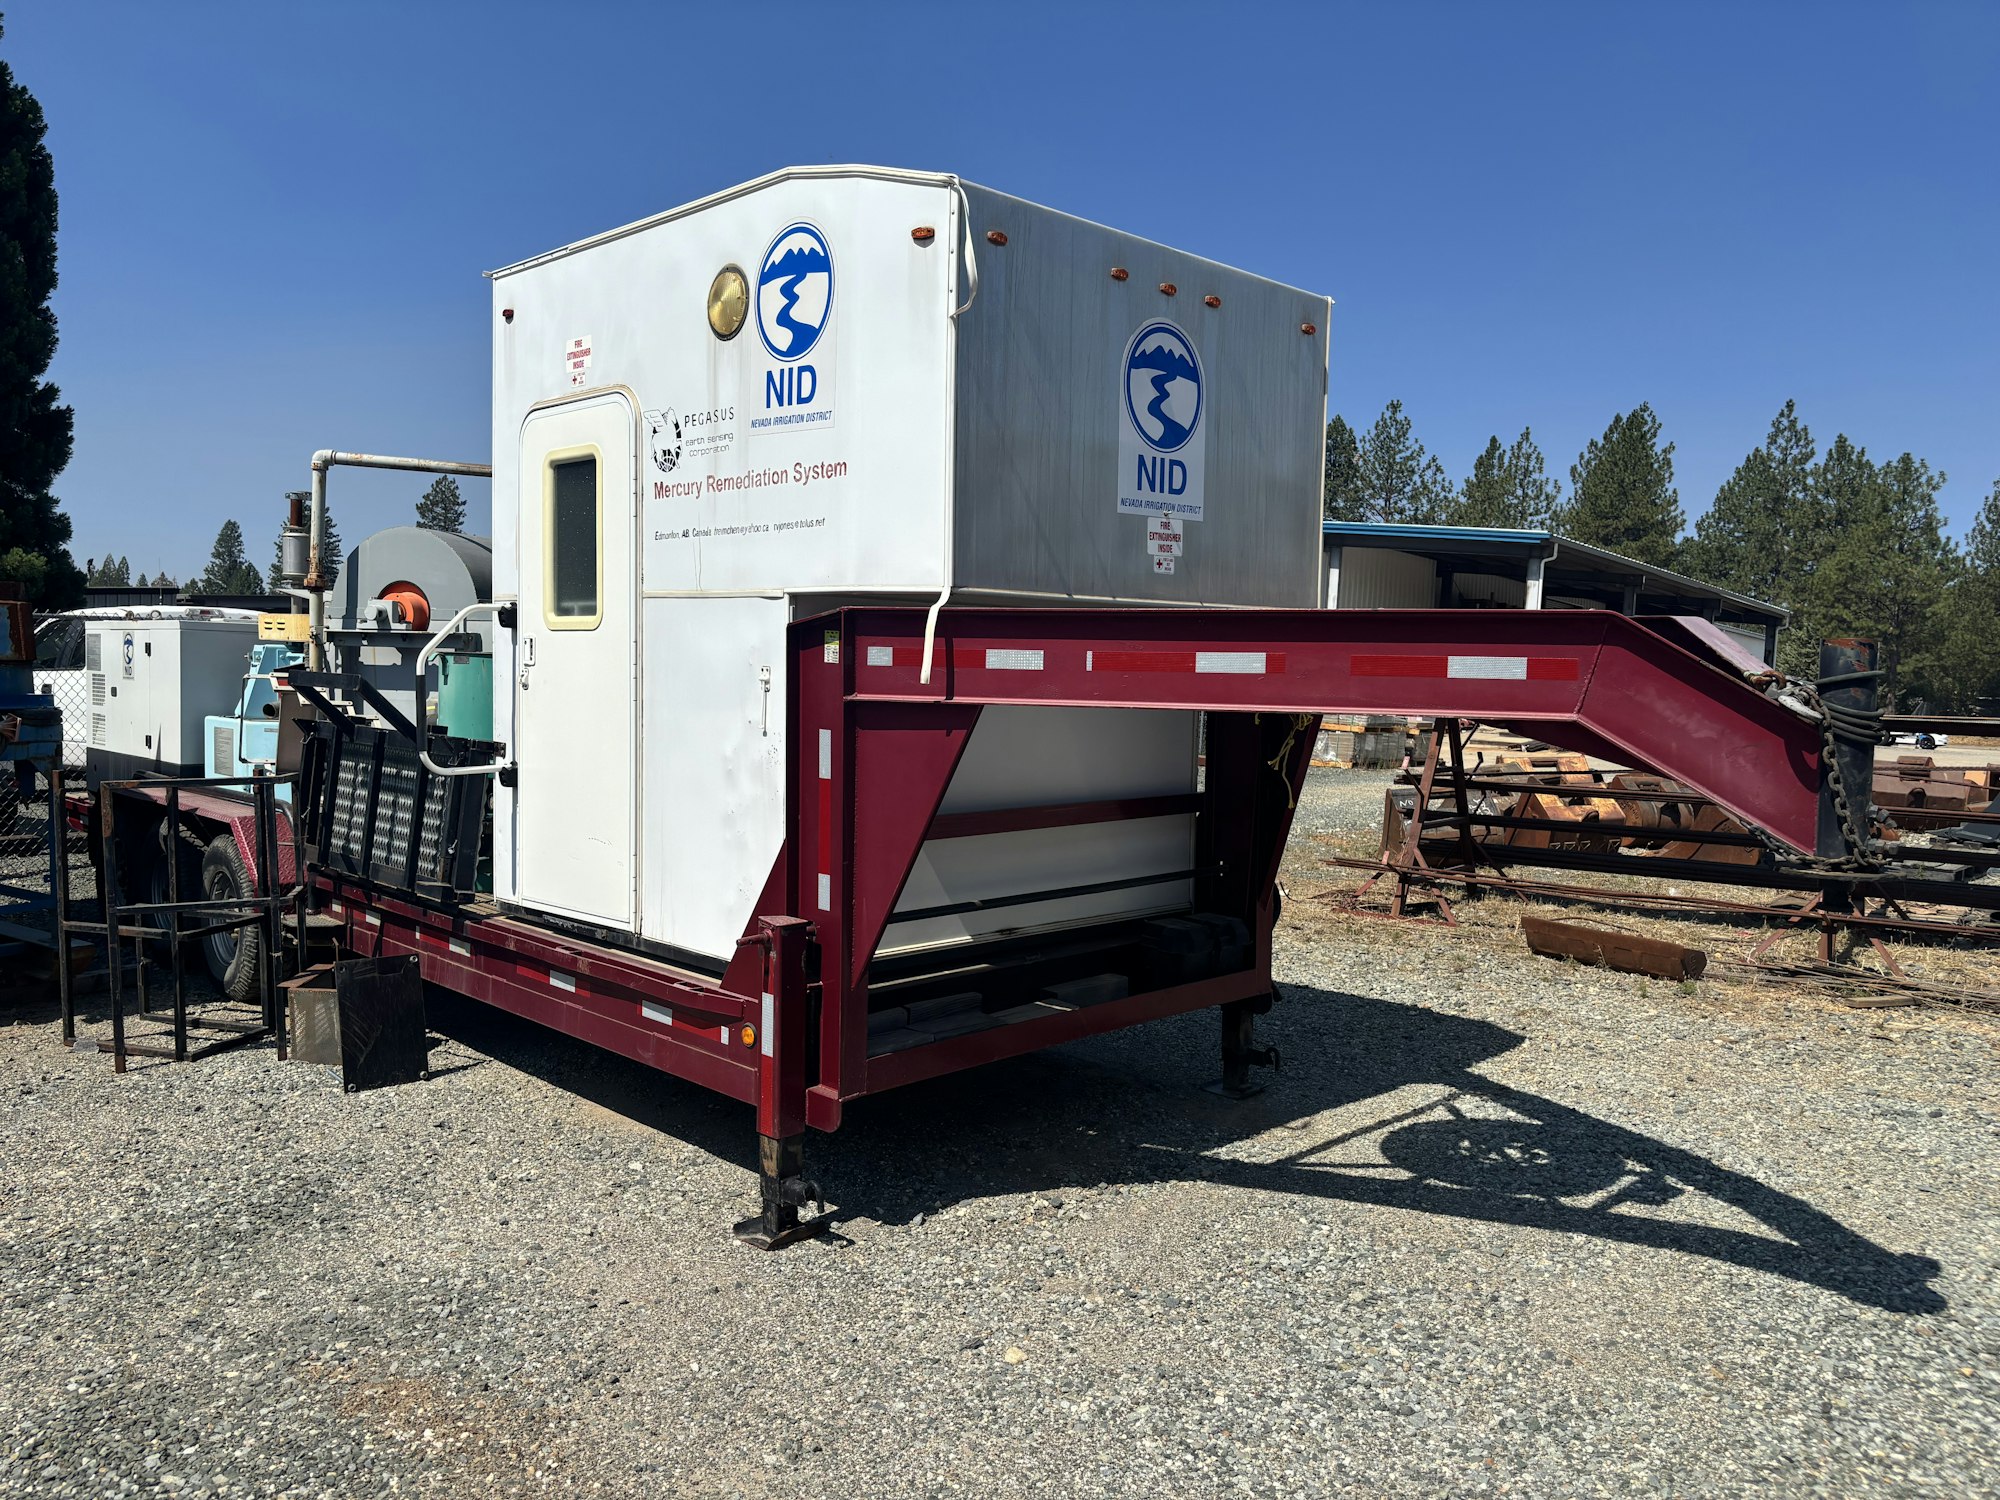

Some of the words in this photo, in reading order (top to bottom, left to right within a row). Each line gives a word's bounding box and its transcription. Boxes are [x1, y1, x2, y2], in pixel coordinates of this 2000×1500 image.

[574, 339, 583, 349] FIRE
[567, 347, 591, 361] EXTINGUISHER
[572, 359, 585, 370] INSIDE
[766, 364, 817, 408] NID
[684, 406, 735, 428] PEGASUS
[751, 417, 772, 429] NEVADA
[773, 413, 805, 426] IRRIGATION
[805, 410, 833, 423] DISTRICT
[685, 435, 705, 447] earth
[707, 431, 734, 445] sensing
[689, 444, 730, 458] corporation
[654, 480, 703, 500] Mercury
[706, 467, 789, 493] Remediation
[793, 460, 848, 486] System
[1137, 454, 1187, 495] NID
[1120, 497, 1143, 509] NEVADA
[1144, 499, 1176, 512] IRRIGATION
[1176, 503, 1202, 515] DISTRICT
[692, 526, 712, 538] Canada
[1160, 520, 1171, 531] FIRE
[1149, 531, 1182, 543] EXTINGUISHER
[1157, 543, 1173, 554] INSIDE
